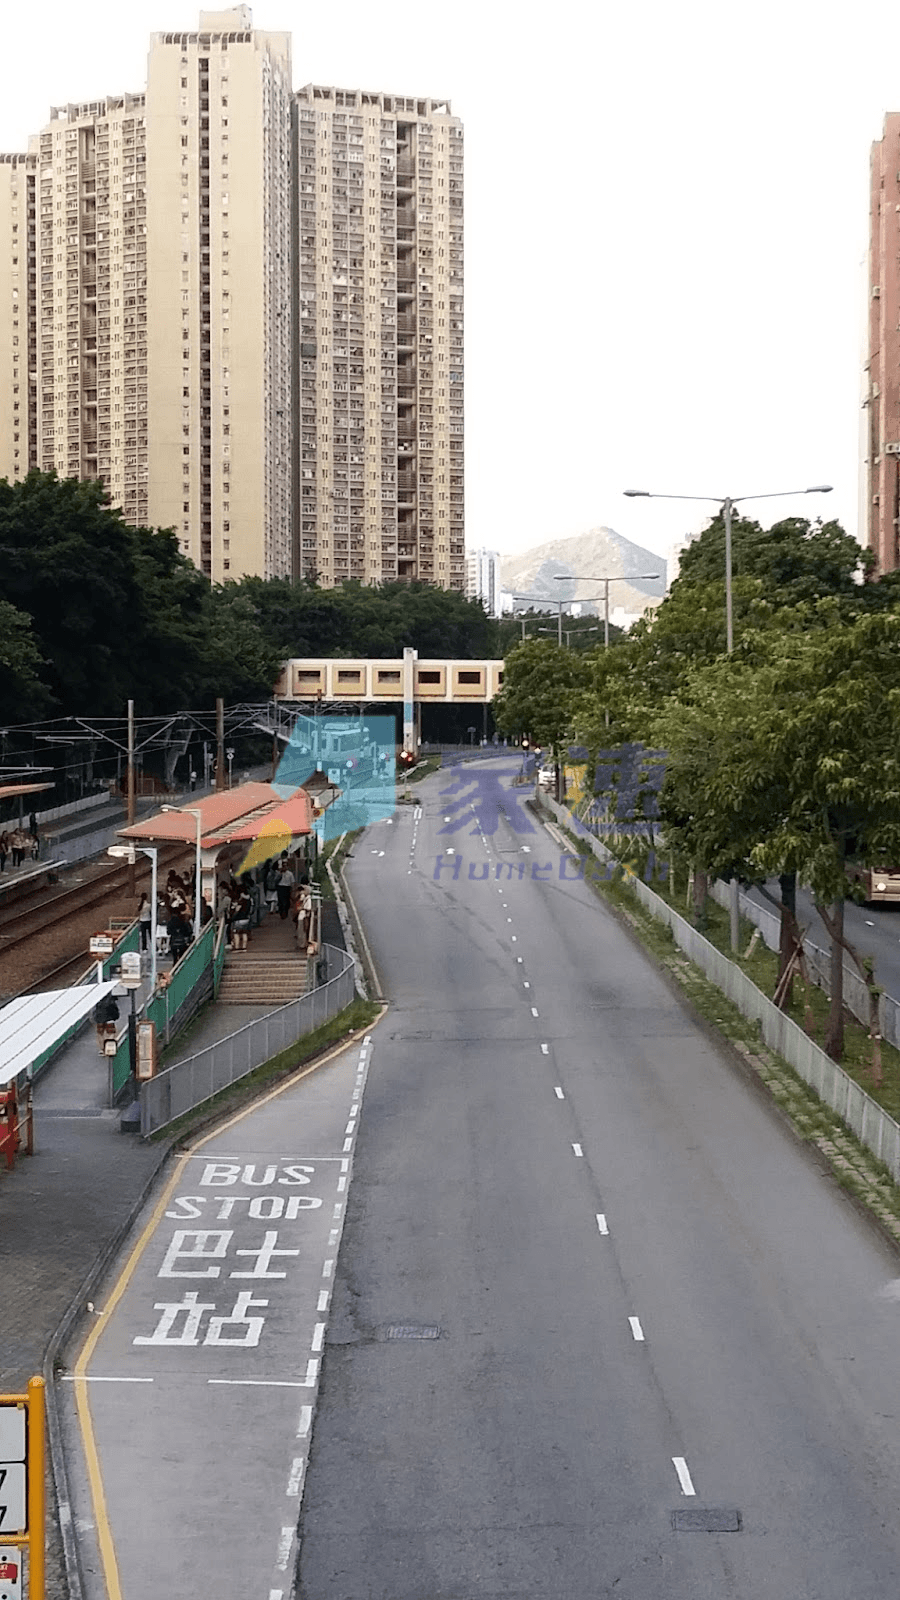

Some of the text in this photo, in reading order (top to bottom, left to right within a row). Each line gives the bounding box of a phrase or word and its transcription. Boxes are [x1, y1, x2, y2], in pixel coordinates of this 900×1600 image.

[199, 1163, 315, 1186] BUS
[165, 1196, 323, 1219] STOP
[157, 1229, 300, 1279] 巴士
[132, 1291, 269, 1347] 站
